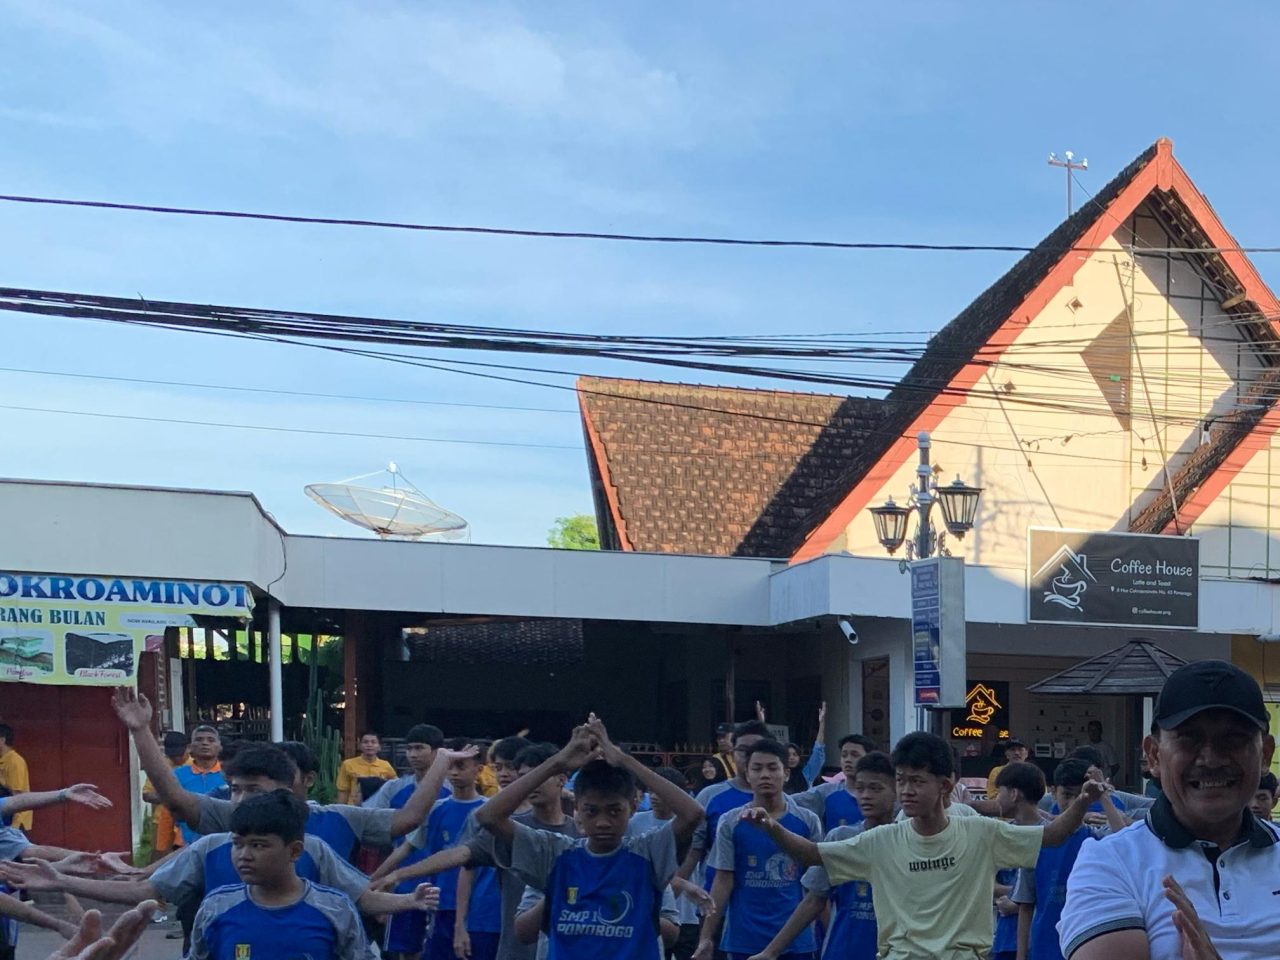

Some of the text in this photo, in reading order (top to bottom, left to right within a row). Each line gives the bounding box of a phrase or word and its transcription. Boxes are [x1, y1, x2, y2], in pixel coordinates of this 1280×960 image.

[1111, 558, 1193, 577] Coffee House
[49, 609, 105, 626] BULAN
[953, 726, 983, 738] Coffee
[558, 908, 590, 922] SMP
[557, 923, 634, 938] PONOROGO
